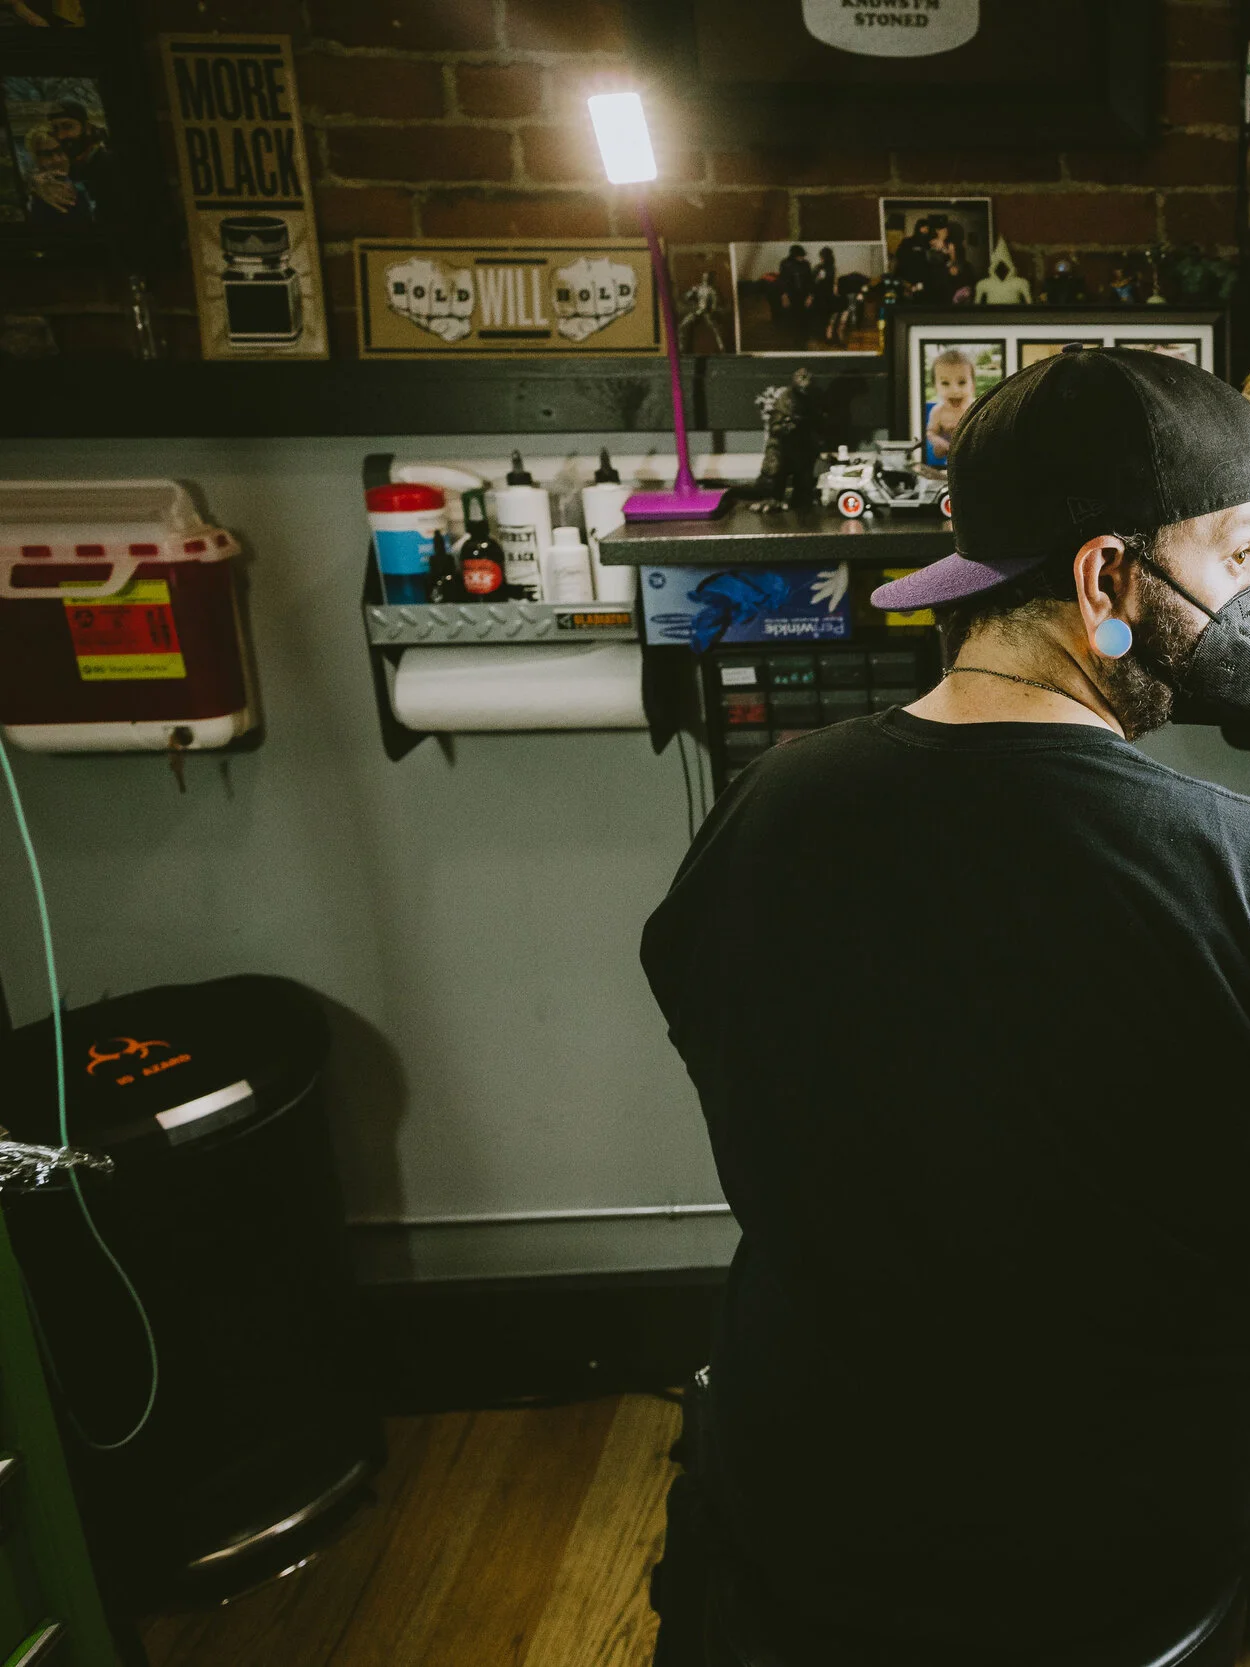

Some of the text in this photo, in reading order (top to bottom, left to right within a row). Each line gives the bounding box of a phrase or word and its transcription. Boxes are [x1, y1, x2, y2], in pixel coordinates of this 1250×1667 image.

[854, 12, 929, 27] STONED
[172, 57, 292, 121] MORE
[185, 126, 304, 197] BLACK
[393, 267, 631, 327] BOLD WILL HOLD
[764, 621, 845, 639] Periwinkle
